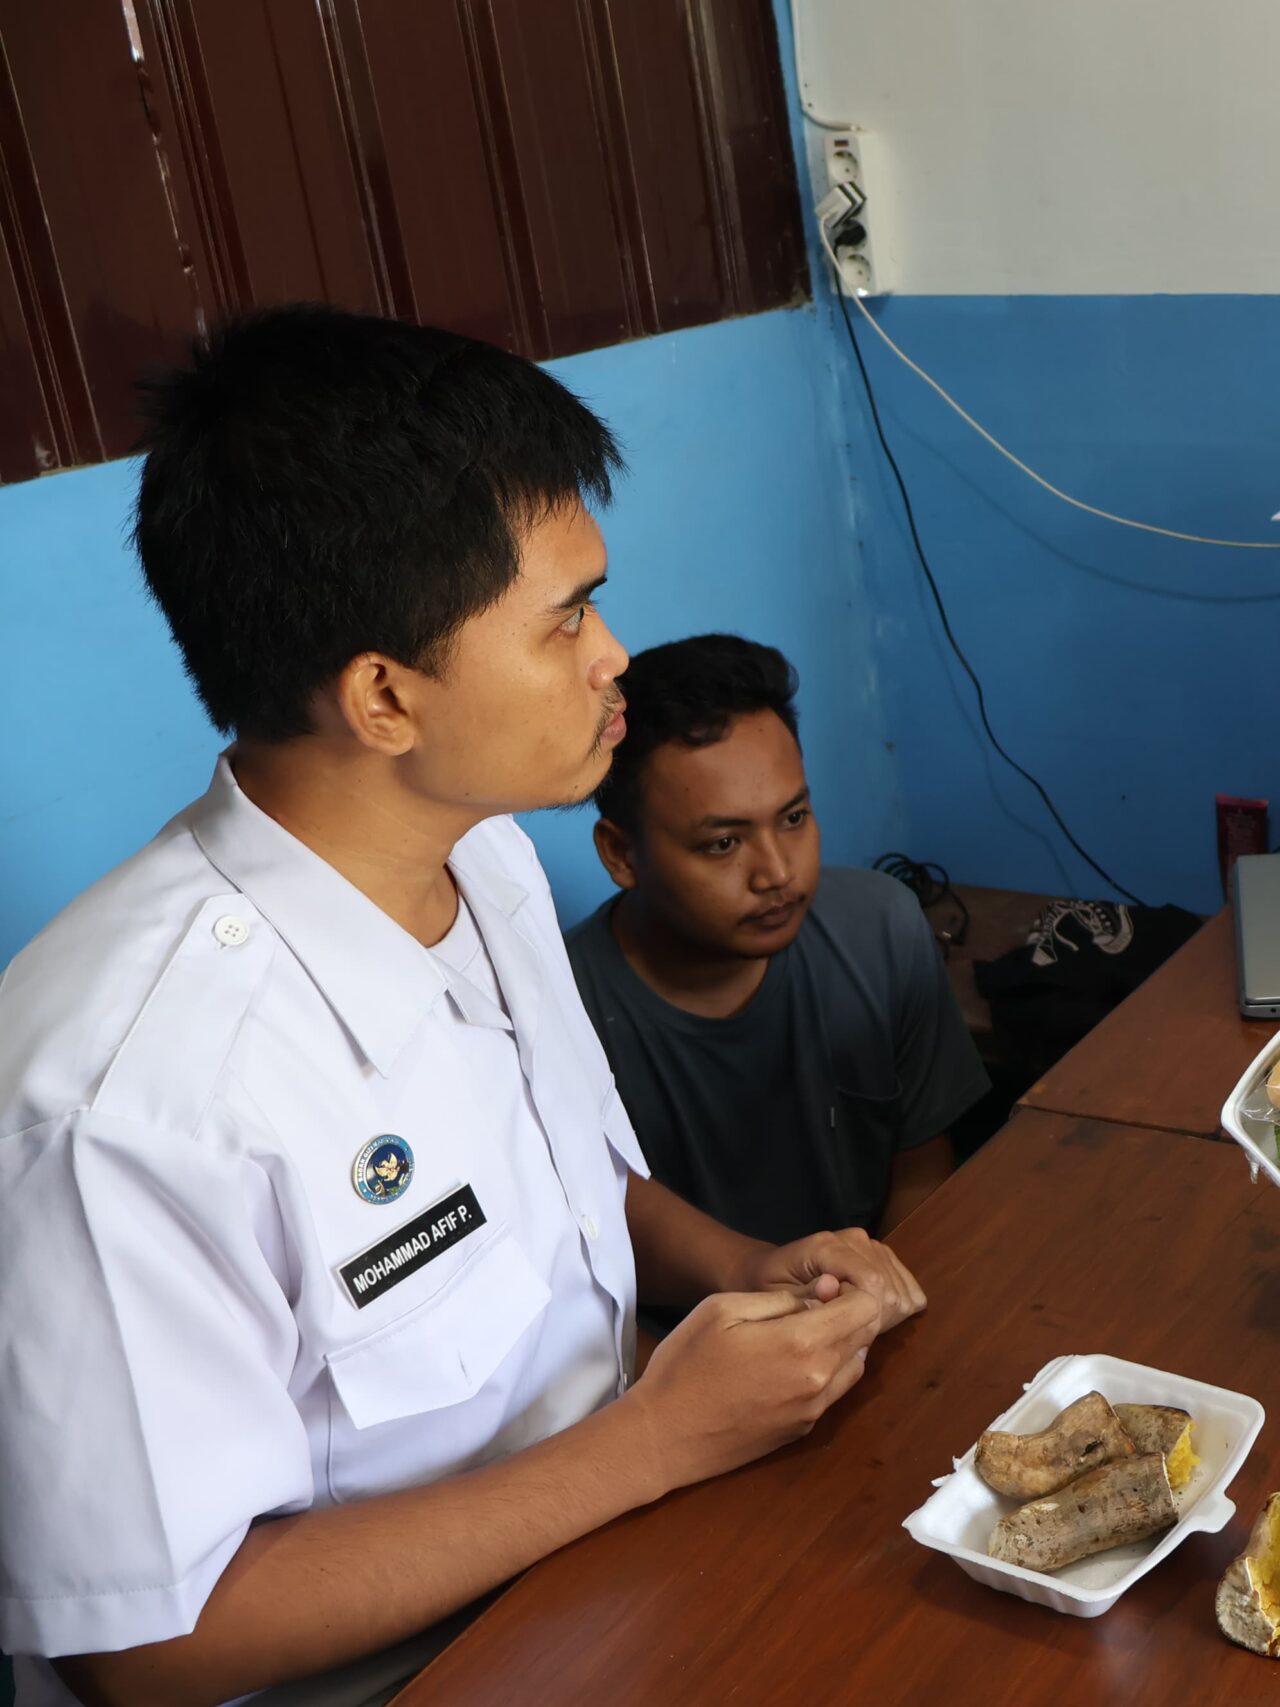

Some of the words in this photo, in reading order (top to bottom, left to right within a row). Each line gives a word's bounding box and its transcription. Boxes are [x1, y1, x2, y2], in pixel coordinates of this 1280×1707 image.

[353, 1231, 431, 1294] MOHAMMAD
[431, 1211, 458, 1242] AFIF
[457, 1204, 472, 1223] P.
